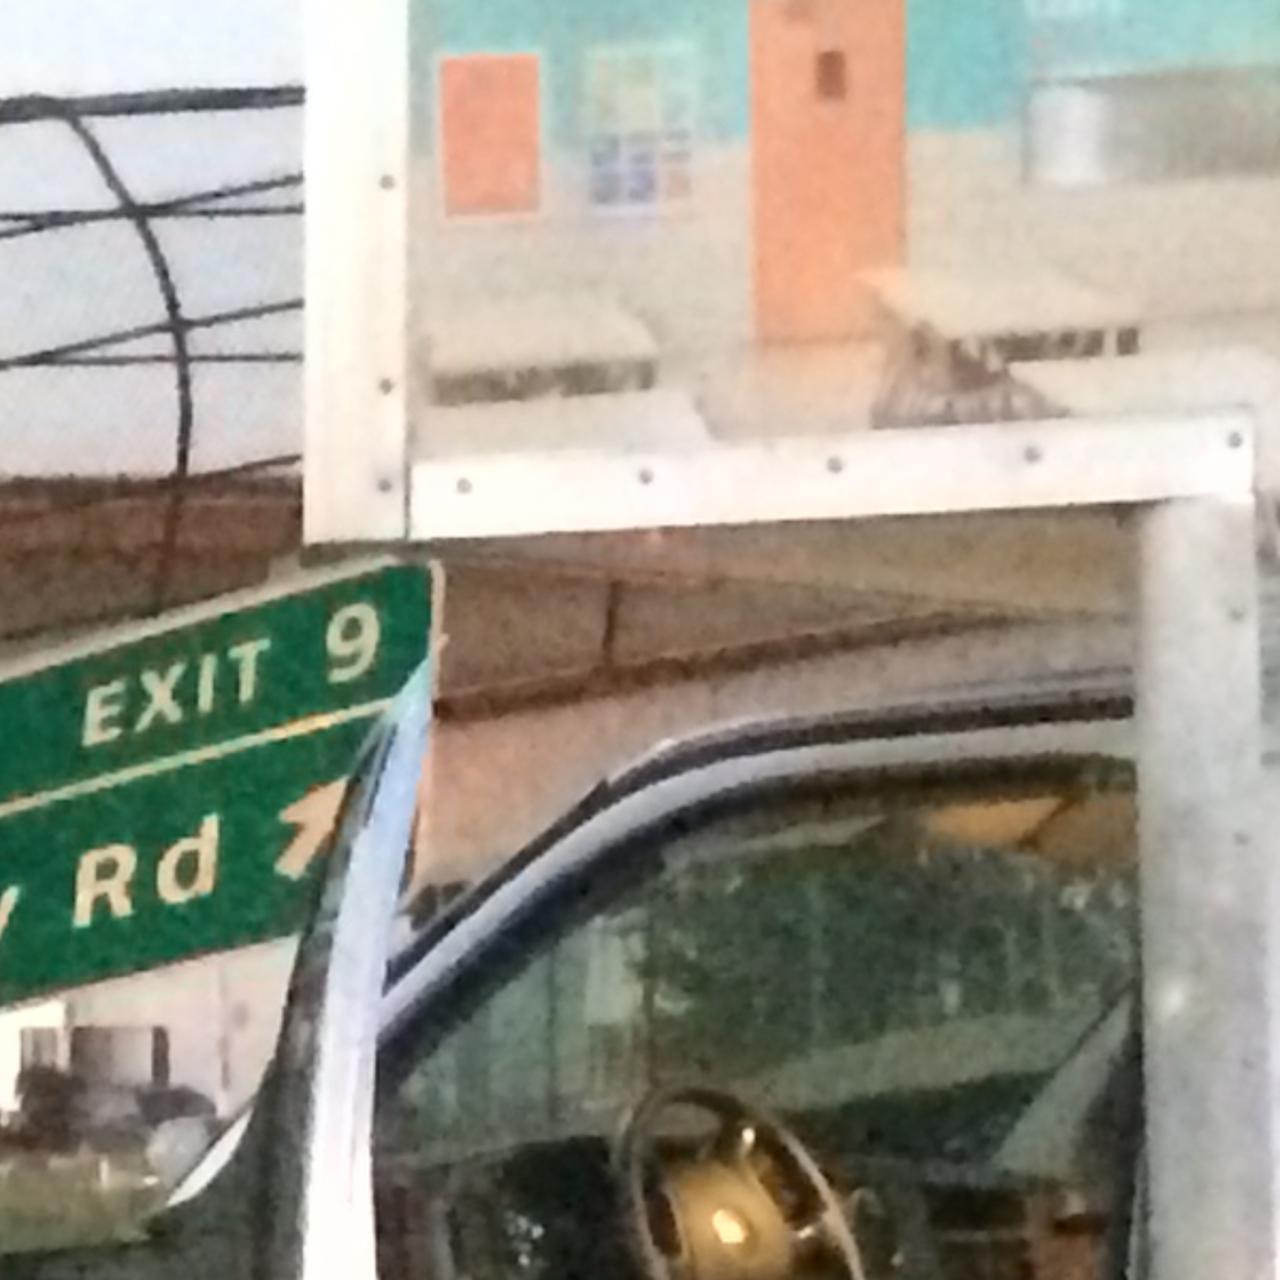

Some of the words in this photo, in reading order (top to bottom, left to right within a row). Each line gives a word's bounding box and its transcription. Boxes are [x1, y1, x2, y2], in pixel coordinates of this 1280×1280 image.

[83, 639, 272, 746] EXIT
[325, 603, 383, 683] 9
[72, 814, 220, 928] Rd
